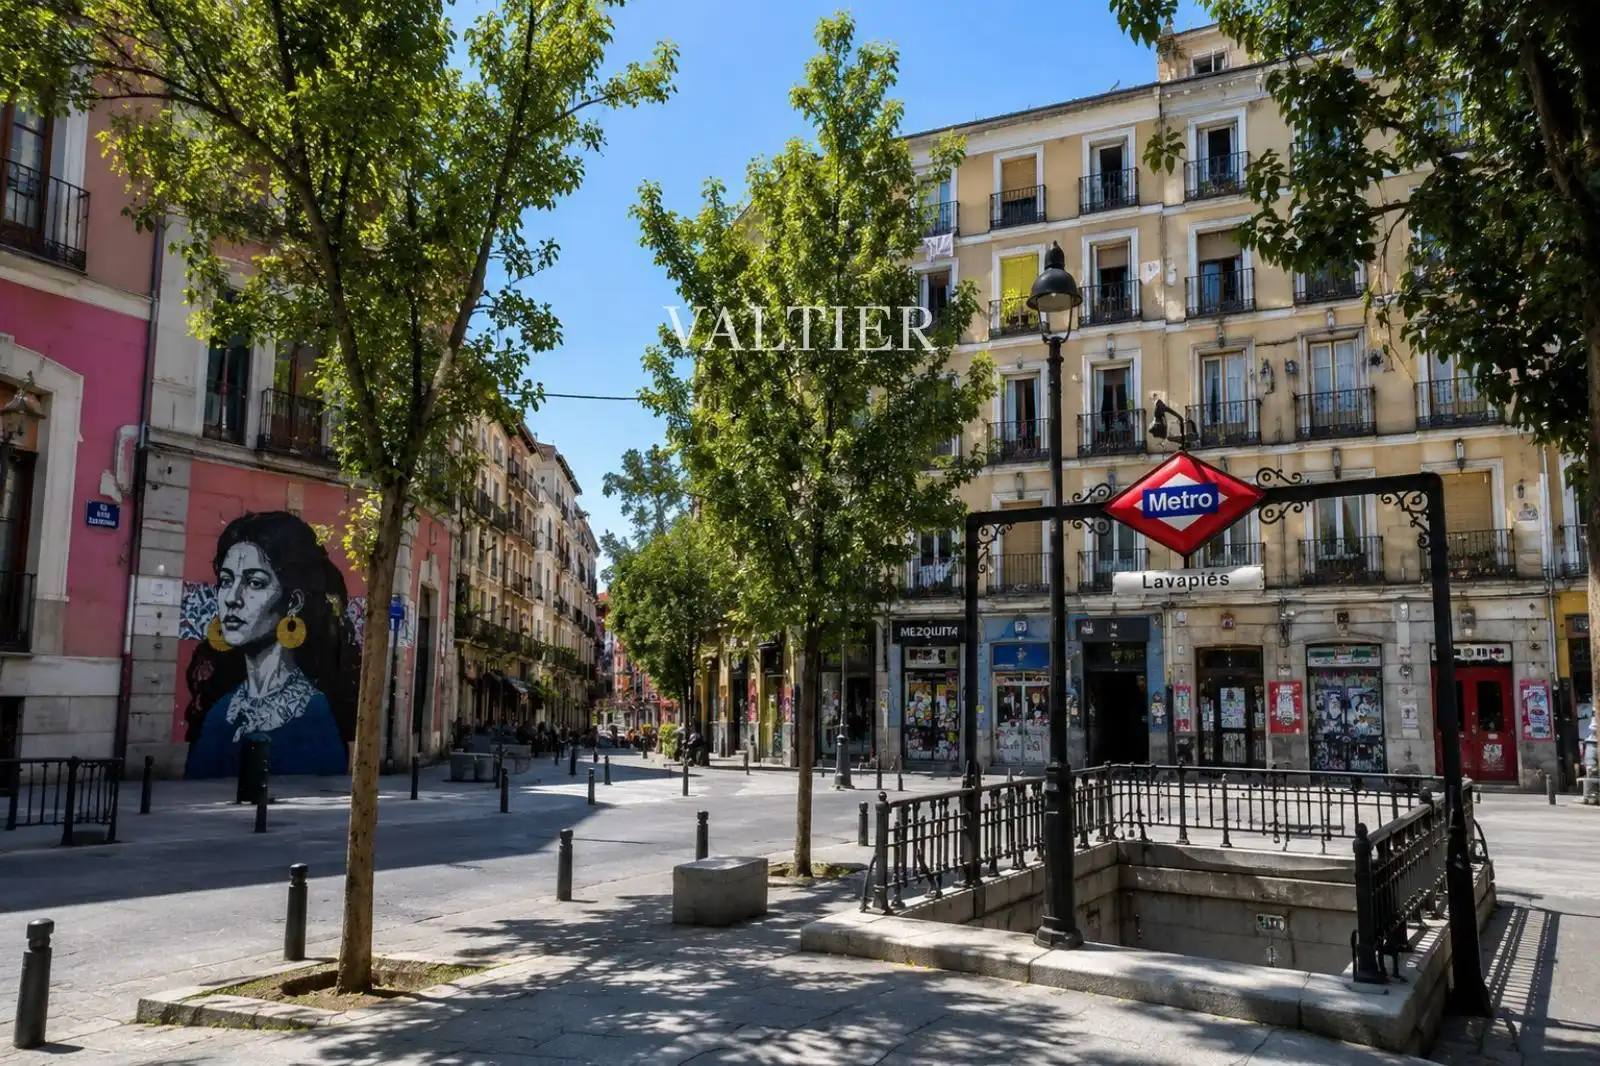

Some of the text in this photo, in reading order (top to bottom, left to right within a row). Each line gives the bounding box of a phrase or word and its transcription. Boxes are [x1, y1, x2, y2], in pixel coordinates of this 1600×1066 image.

[1149, 491, 1212, 512] Metro
[1143, 572, 1229, 591] Lavapiés
[900, 626, 958, 639] MEZQUITA
